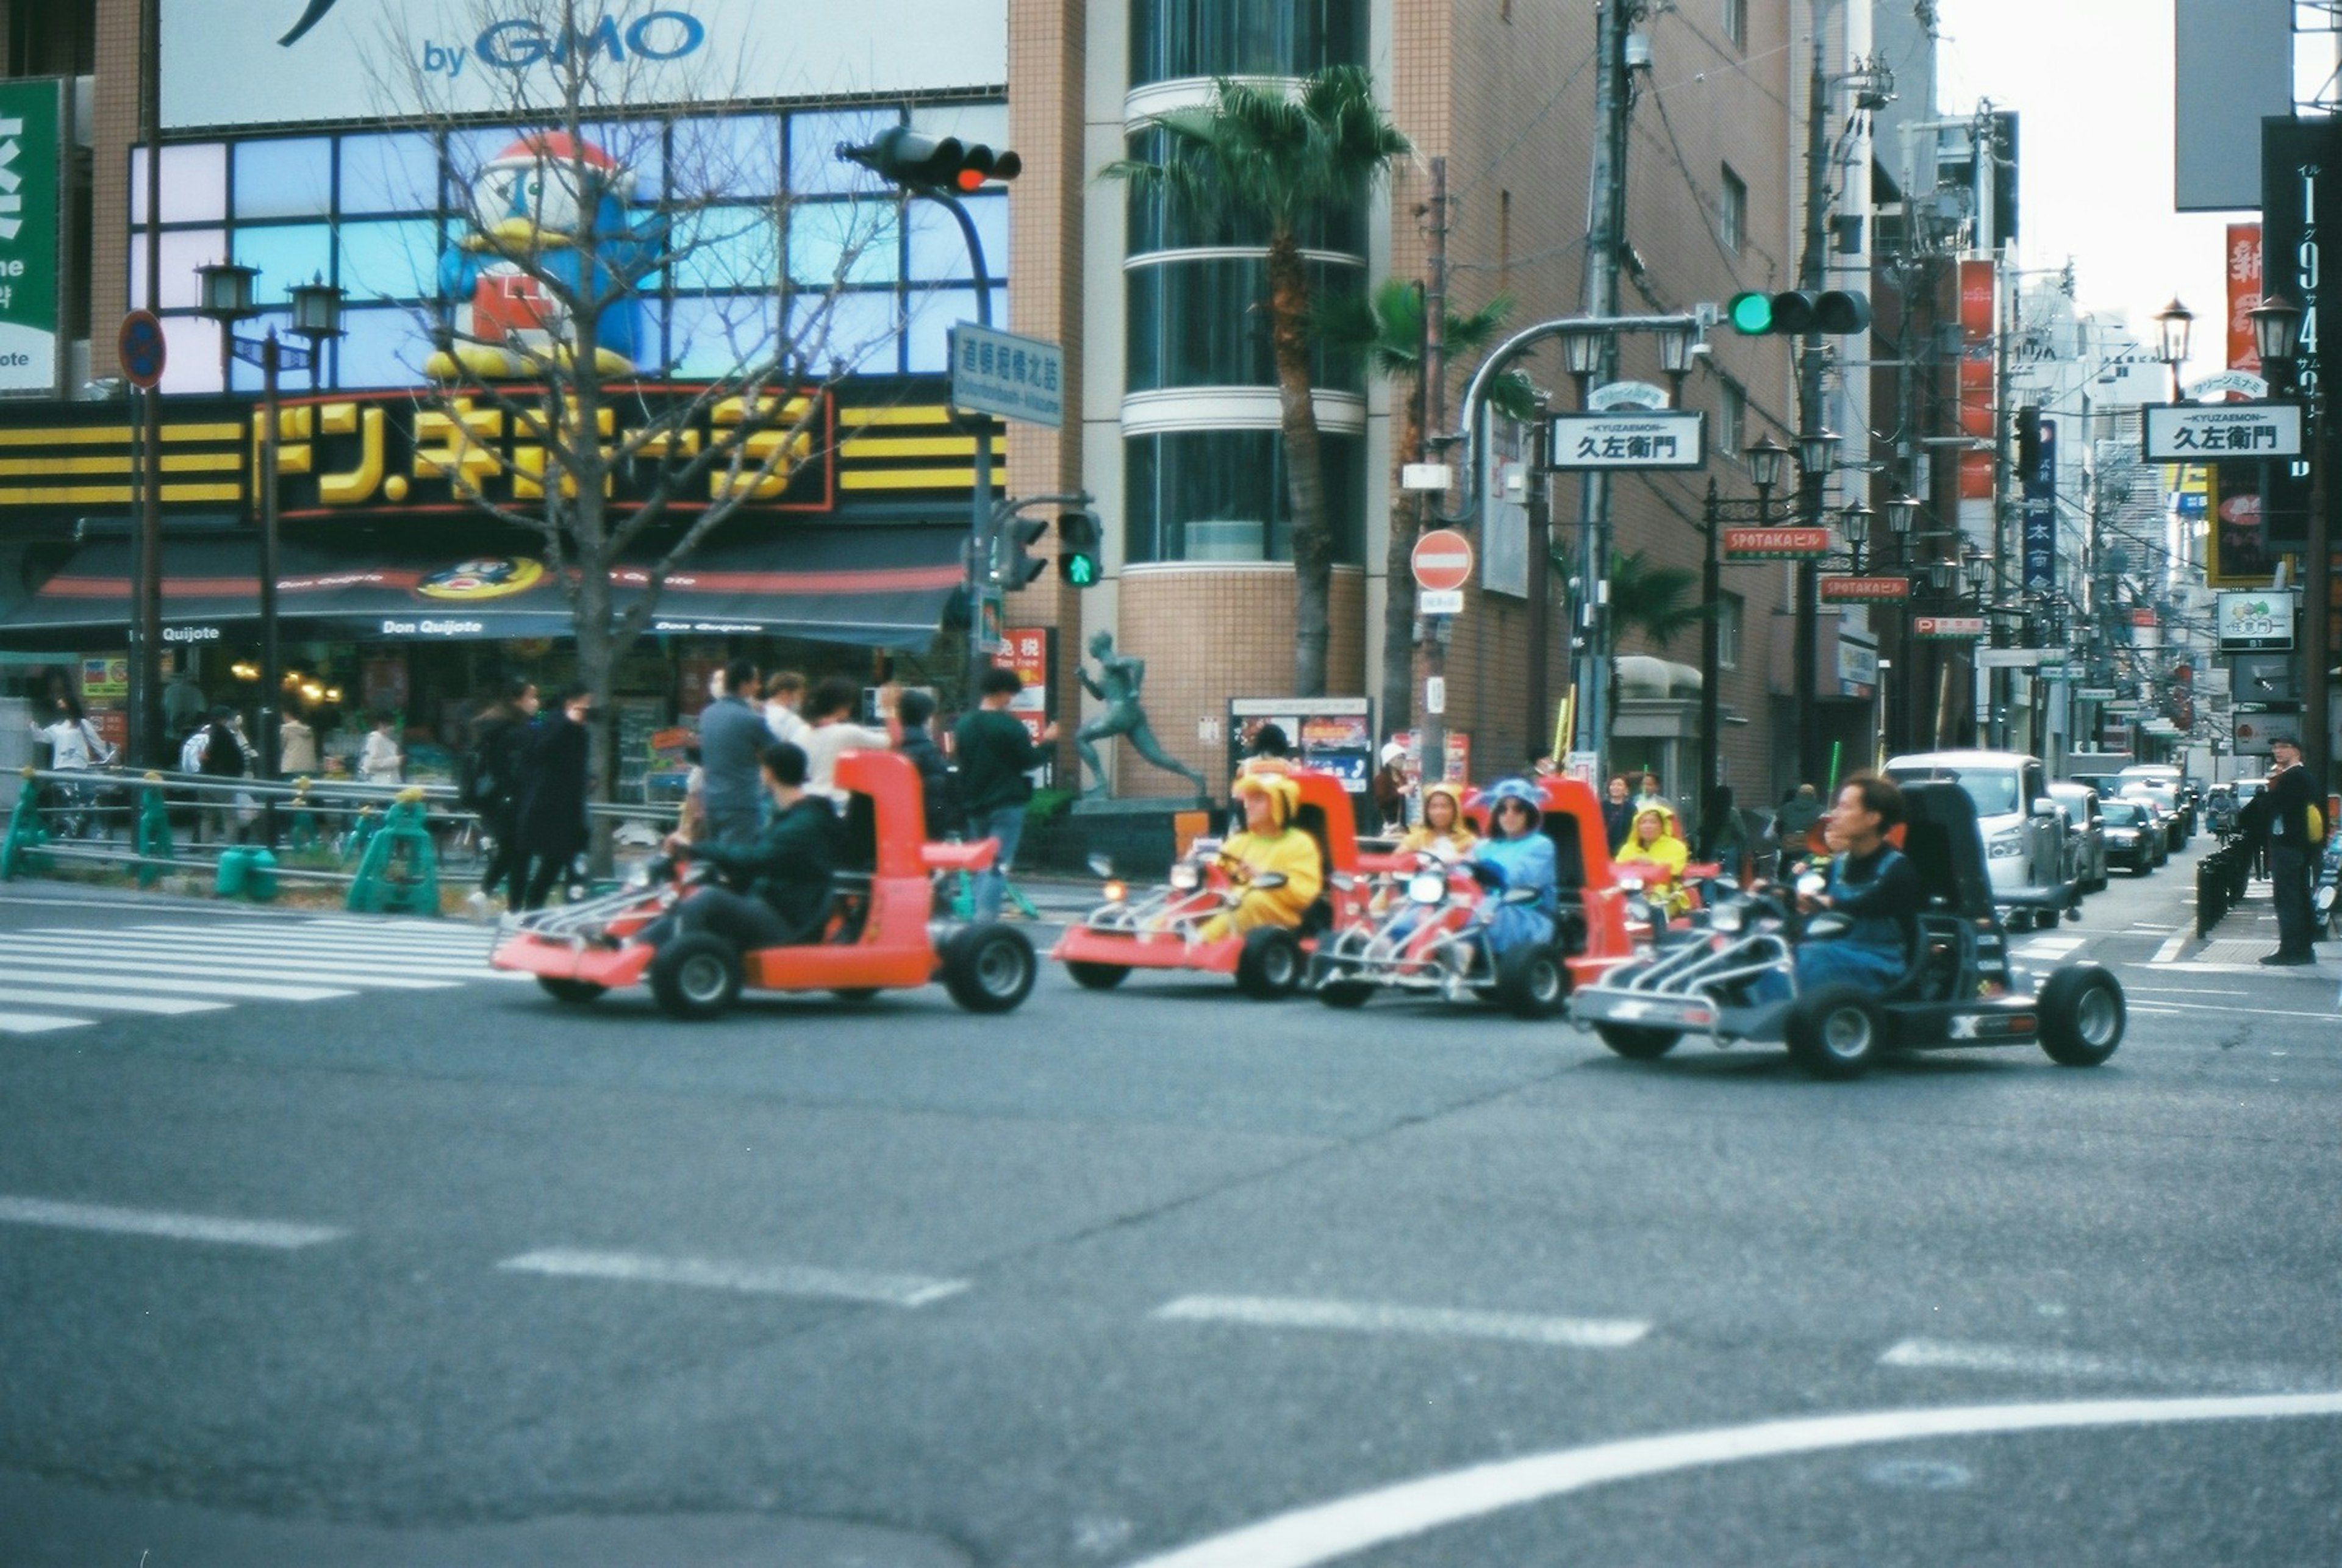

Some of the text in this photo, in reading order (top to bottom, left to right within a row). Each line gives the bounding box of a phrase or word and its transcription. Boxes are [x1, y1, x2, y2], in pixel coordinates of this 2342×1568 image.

[424, 11, 705, 77] by GMO
[1577, 435, 1676, 458] 久左衛門
[2174, 426, 2277, 449] 久左衛門
[163, 626, 220, 643] Quijote
[382, 620, 483, 636] Don Quijote
